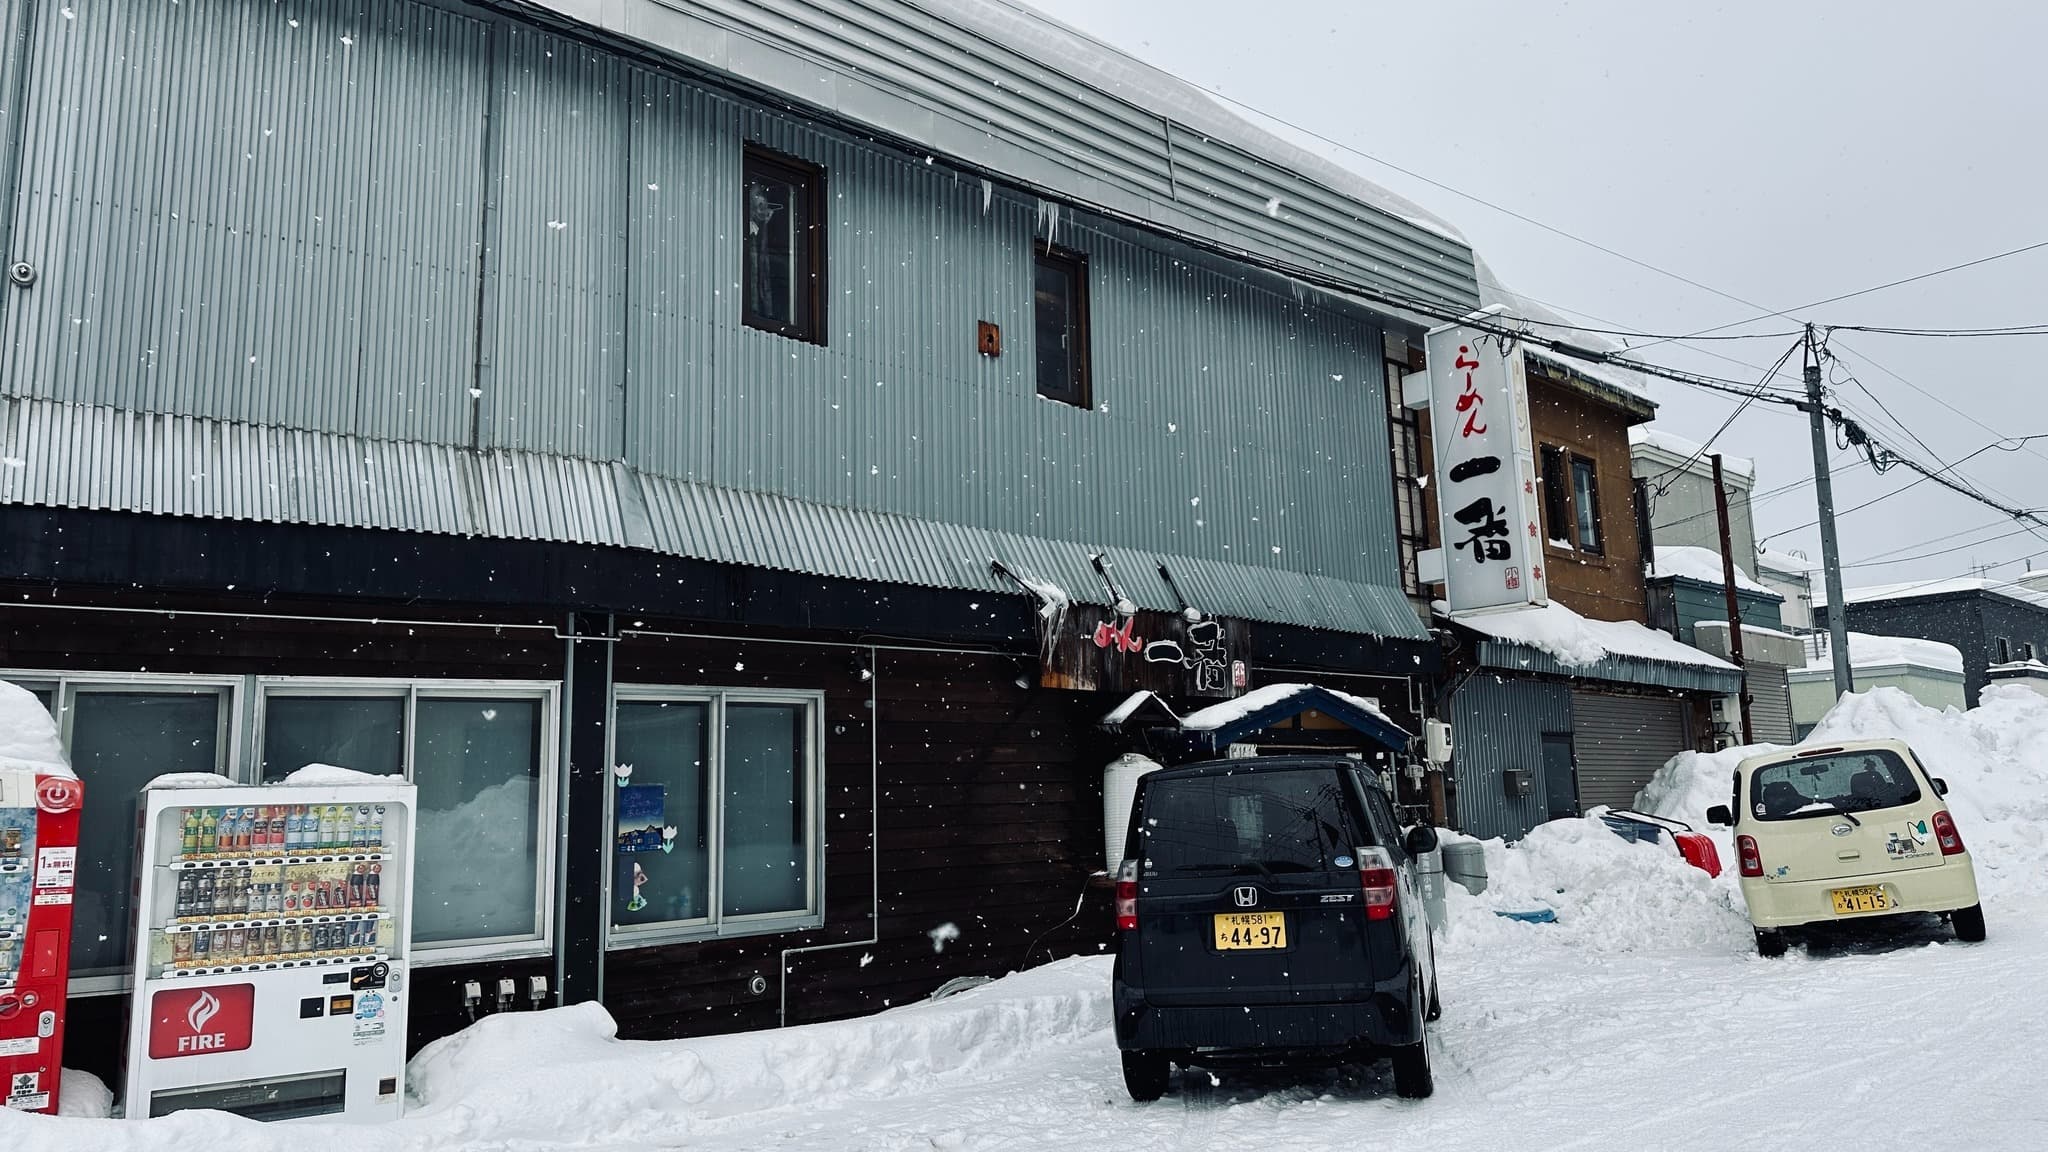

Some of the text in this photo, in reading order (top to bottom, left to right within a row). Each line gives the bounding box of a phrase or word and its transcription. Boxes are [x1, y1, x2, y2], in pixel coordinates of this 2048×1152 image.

[1455, 345, 1487, 438] らーめん
[1449, 456, 1511, 563] 一番
[1320, 894, 1355, 903] ZEST
[178, 1032, 226, 1052] FIRE
